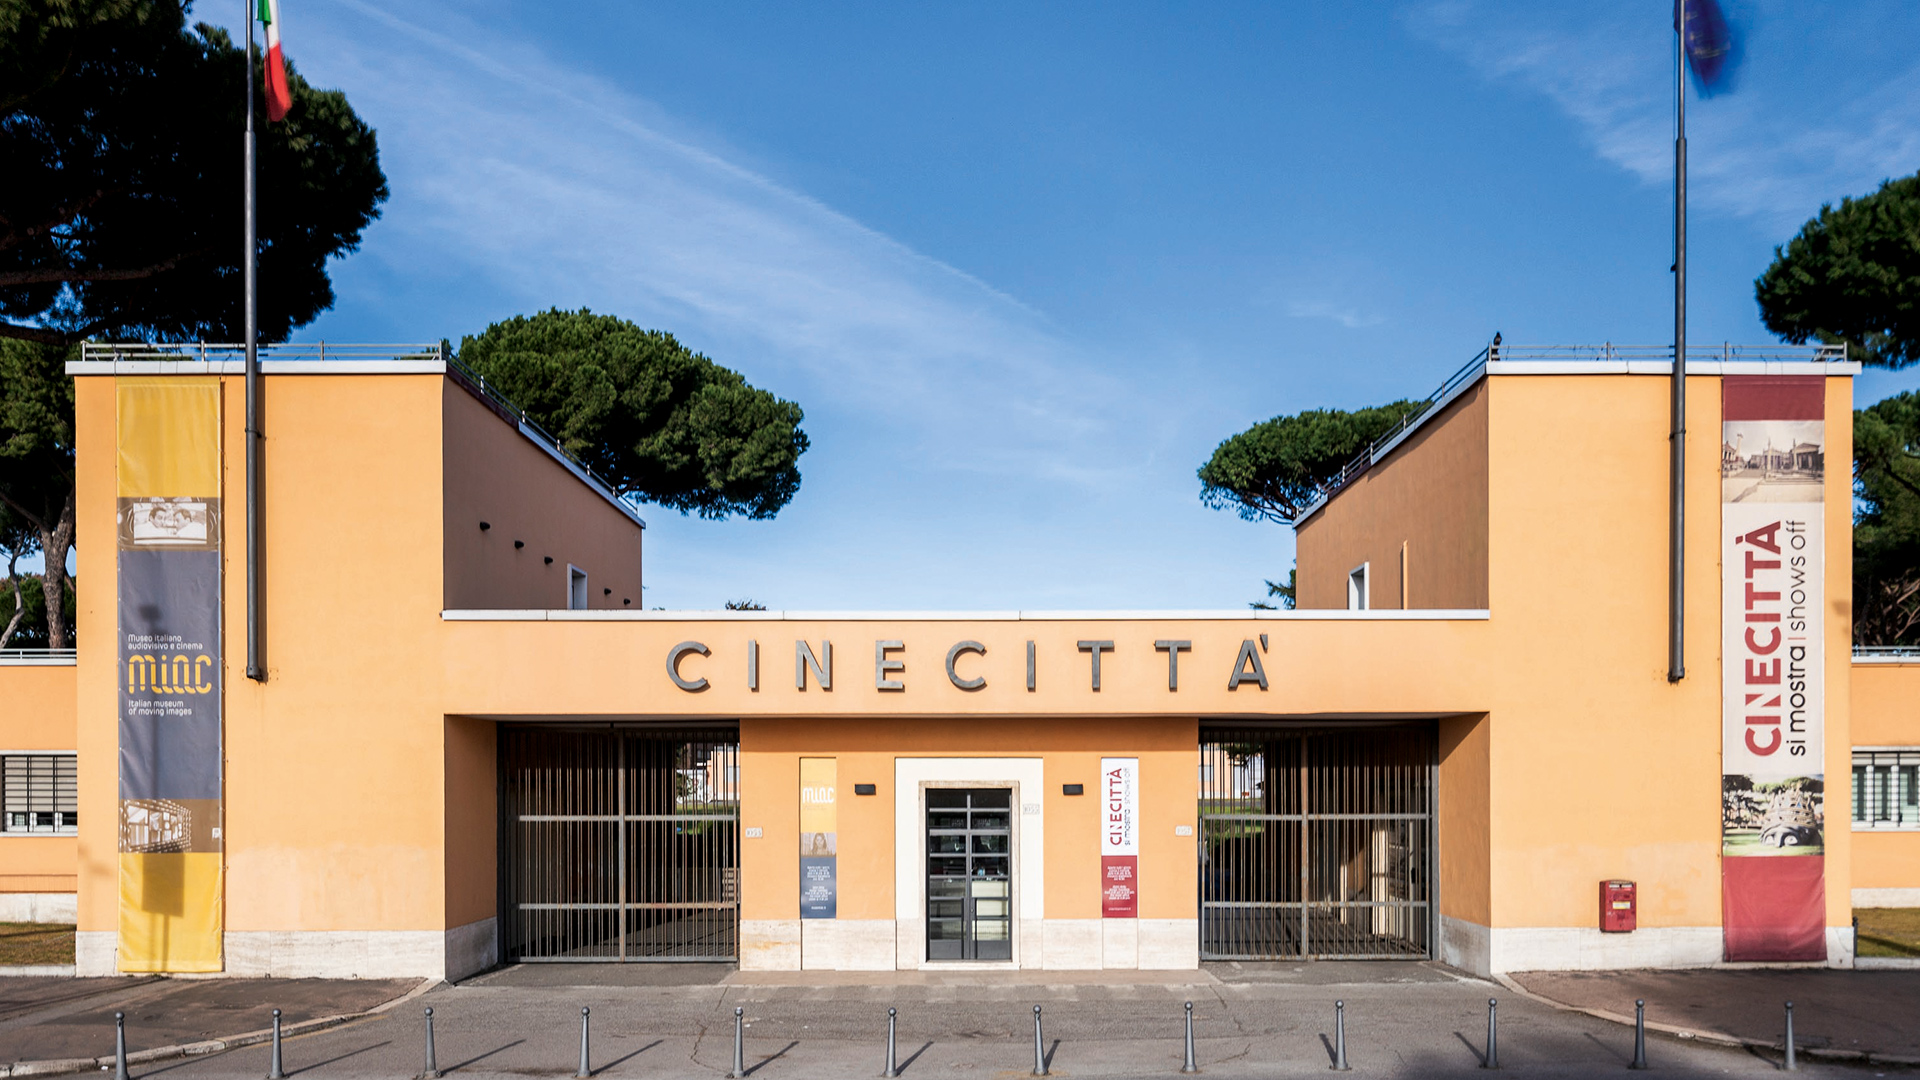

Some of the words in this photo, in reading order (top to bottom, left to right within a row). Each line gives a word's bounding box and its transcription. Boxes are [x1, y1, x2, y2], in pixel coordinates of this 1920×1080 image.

[1786, 520, 1806, 551] off
[1786, 556, 1806, 632] shows
[128, 634, 153, 642] Museo
[128, 642, 168, 650] audiovisivo
[176, 642, 203, 650] cinema
[1735, 520, 1782, 757] CINECITTÀ
[1786, 646, 1806, 733] mostra
[128, 699, 152, 707] Italian
[128, 707, 136, 715] of
[138, 707, 165, 716] moving
[166, 707, 192, 716] images
[1786, 740, 1806, 757] si
[1106, 768, 1122, 846] CINECITTÀ
